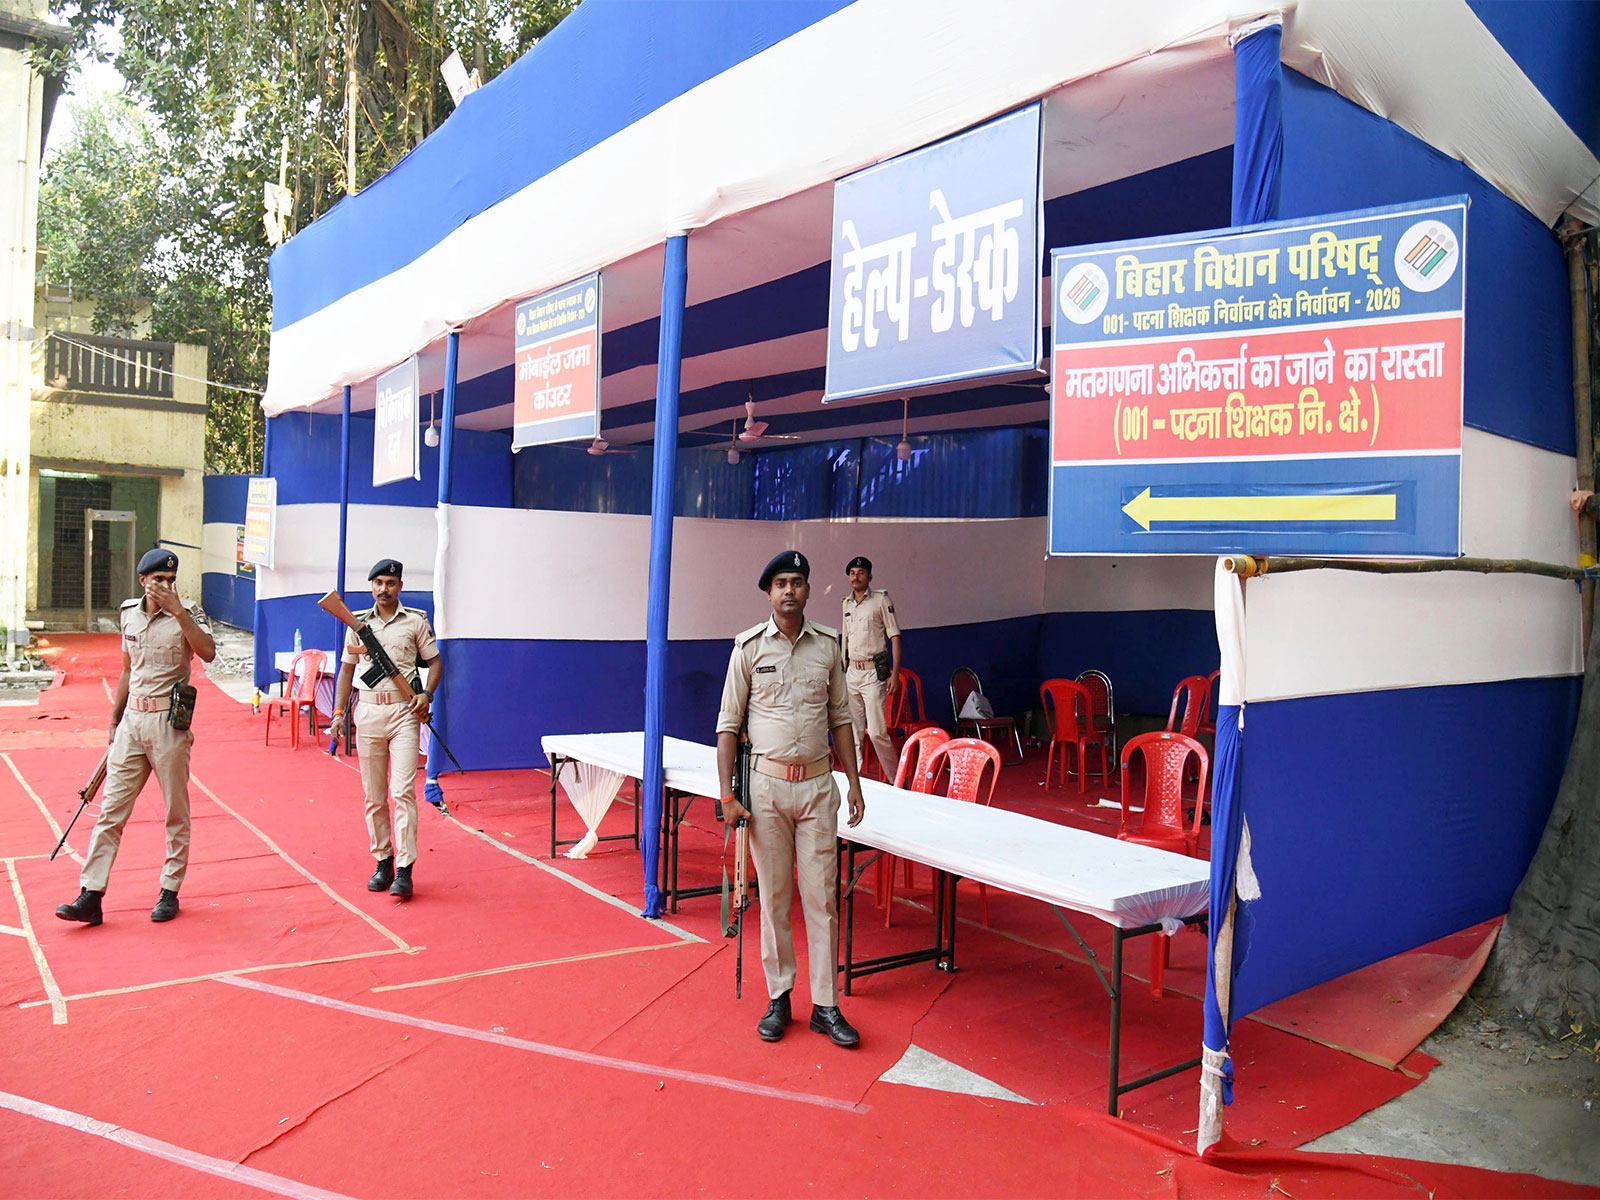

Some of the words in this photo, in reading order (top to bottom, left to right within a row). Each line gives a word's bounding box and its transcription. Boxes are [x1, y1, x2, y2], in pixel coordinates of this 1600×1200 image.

[842, 188, 1024, 353] हेल्प-डेस्क
[1115, 254, 1188, 300] बिहार
[1194, 245, 1281, 292] विधान
[1287, 230, 1384, 286] परिषद्
[1103, 312, 1130, 335] 001-
[1133, 309, 1165, 331] पटना
[1168, 303, 1211, 329] शिक्षक
[1214, 295, 1266, 325] निर्वाचन
[1268, 292, 1293, 320] क्षेत्र
[1296, 286, 1351, 318] निर्वाचन
[1366, 286, 1401, 312] 2026
[561, 343, 592, 370] जमा
[1065, 363, 1155, 399] मतगणना
[1156, 342, 1248, 396] अभिकर्त्ता
[1250, 354, 1282, 389] का
[1283, 336, 1336, 386] जाने
[1343, 346, 1379, 383] का
[1380, 341, 1446, 382] रास्ता
[1113, 398, 1149, 456] (001
[1169, 406, 1223, 441] पटना
[1225, 391, 1295, 440] शिक्षक
[1297, 386, 1333, 436] नि.
